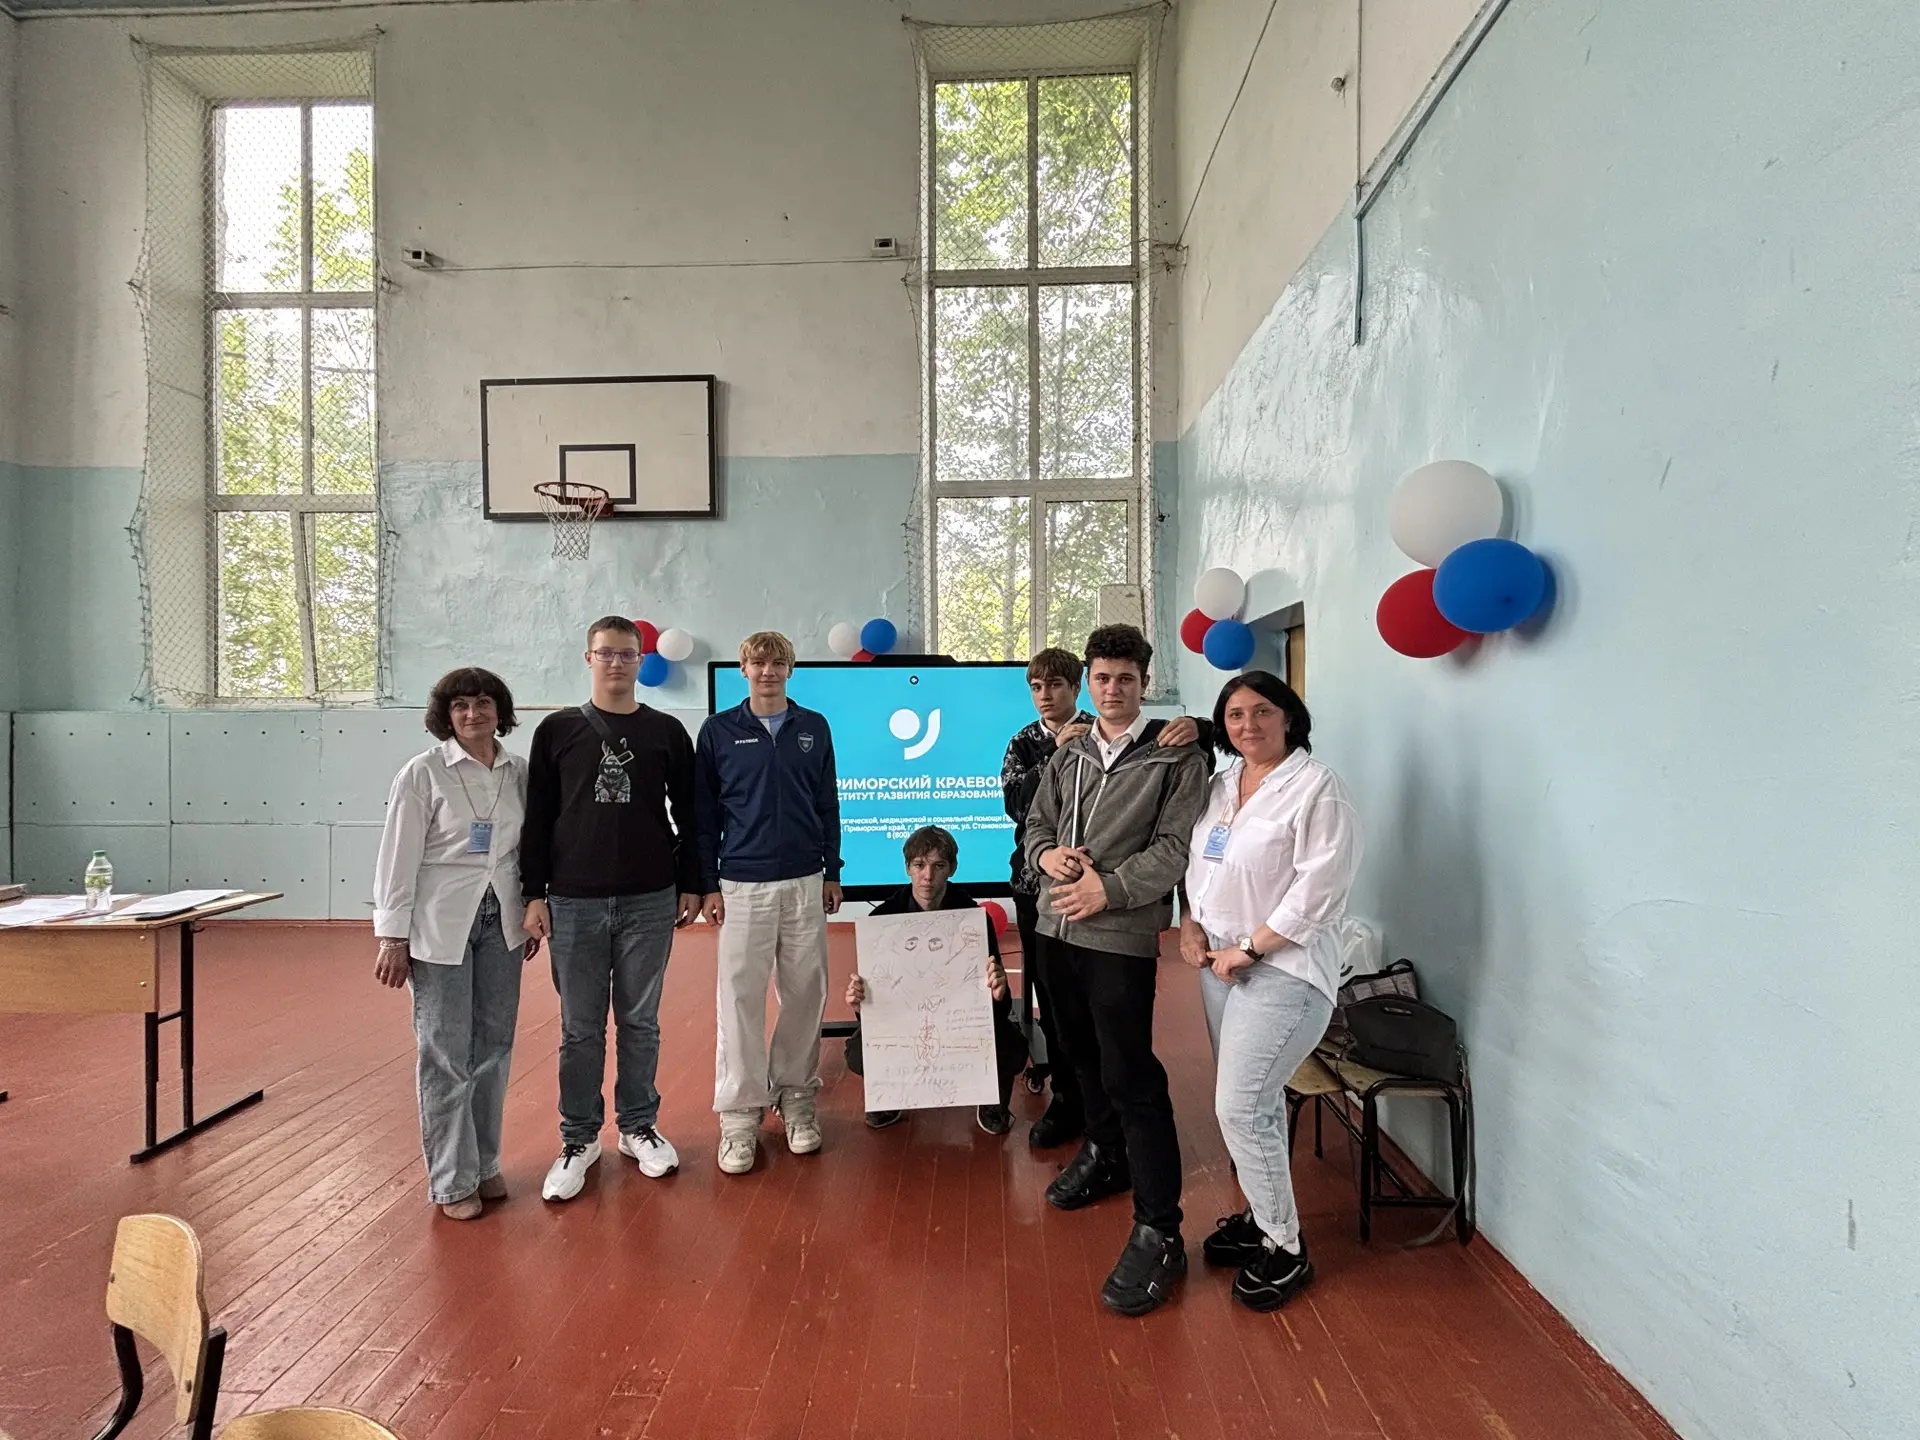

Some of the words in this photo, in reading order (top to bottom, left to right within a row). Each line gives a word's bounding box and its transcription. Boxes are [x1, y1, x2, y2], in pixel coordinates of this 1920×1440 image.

[877, 791, 931, 800] РАЗВИТИЯ
[840, 816, 879, 824] огической,
[880, 816, 926, 824] медицинской
[933, 815, 973, 823] социальной
[844, 824, 888, 833] Приморский
